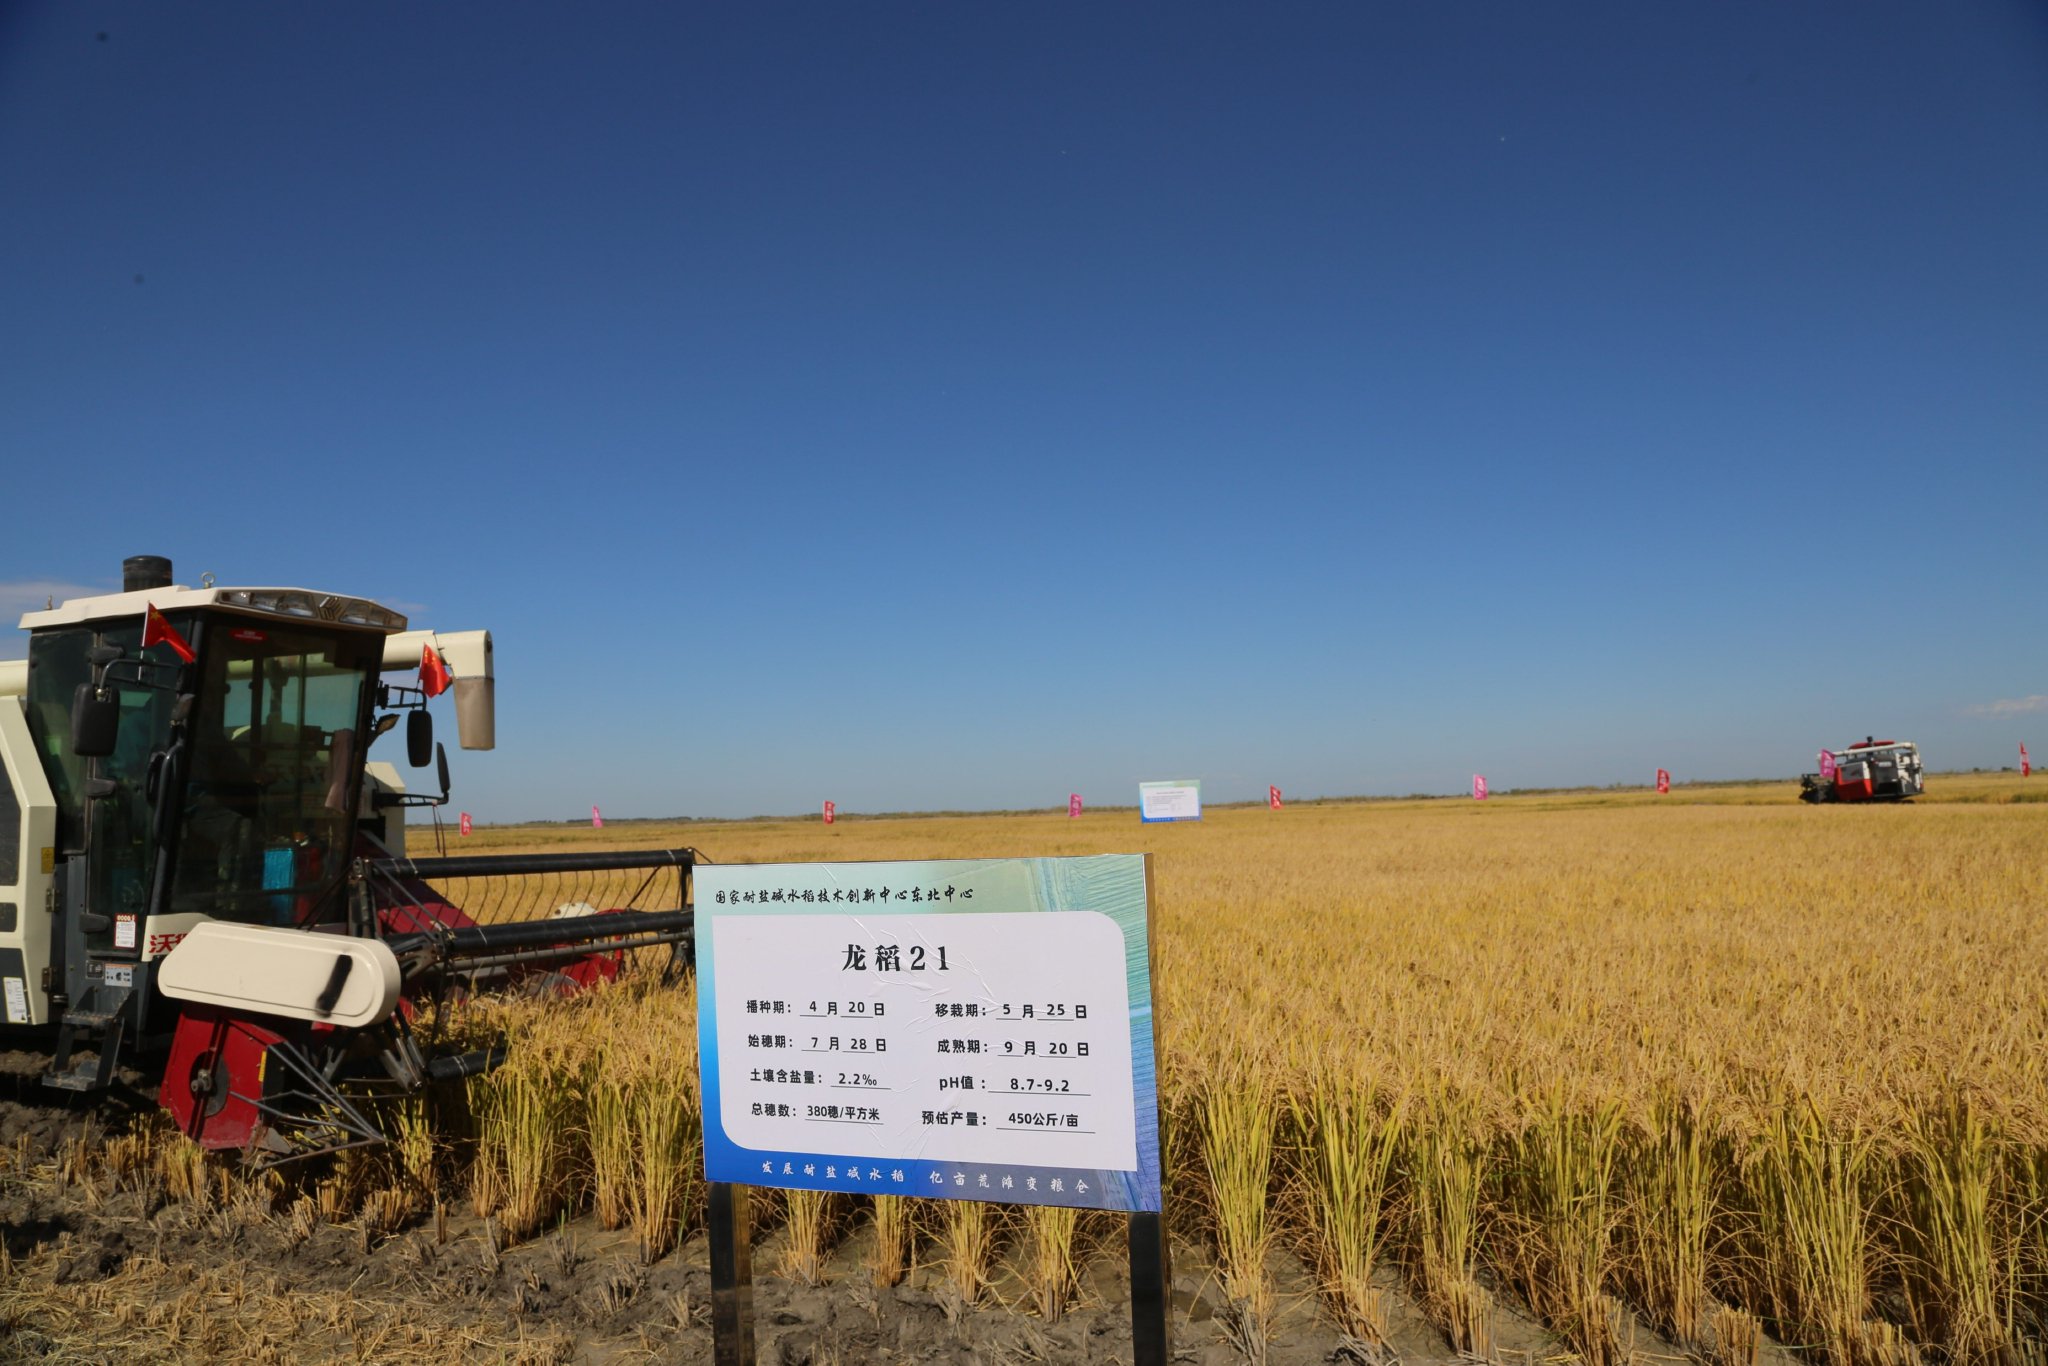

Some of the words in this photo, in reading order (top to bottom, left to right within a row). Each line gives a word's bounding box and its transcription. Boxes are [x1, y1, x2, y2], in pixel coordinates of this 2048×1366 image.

[715, 885, 974, 905] 国家耐盐碱水稻技术创新中心东北中心
[841, 943, 950, 972] 龙稻21
[838, 1072, 878, 1086] 2.2‰
[1010, 1078, 1070, 1092] 8.7-9.2
[807, 1105, 881, 1121] 380穗/平方米
[1008, 1112, 1079, 1127] 450公斤/亩
[762, 1160, 905, 1183] 发展耐盐碱水稻
[929, 1170, 1089, 1194] 亿亩荒滩变粮仓
